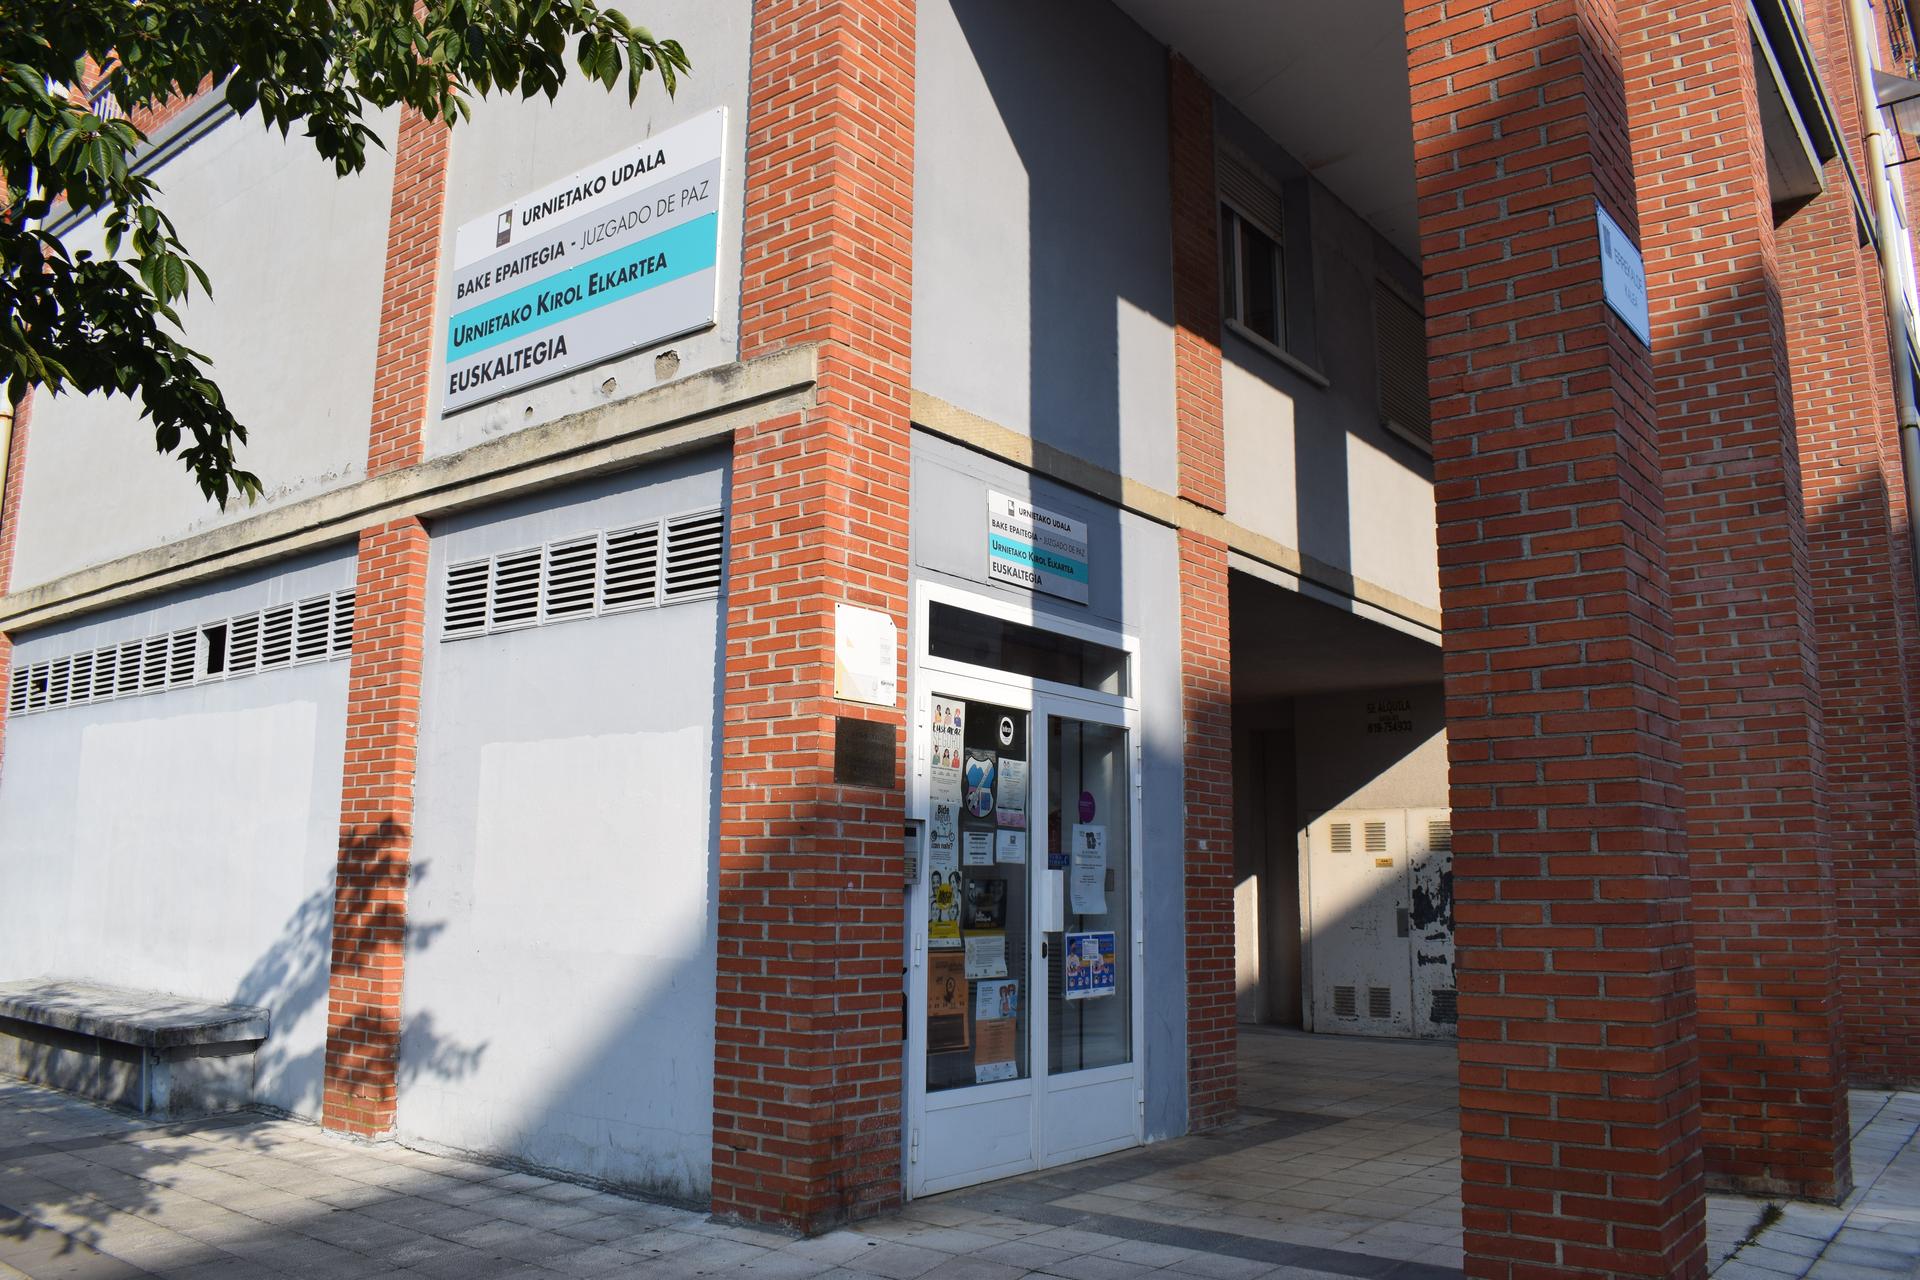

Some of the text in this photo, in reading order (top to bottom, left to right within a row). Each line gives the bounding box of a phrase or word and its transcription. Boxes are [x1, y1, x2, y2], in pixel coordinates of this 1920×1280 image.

[522, 149, 666, 227] URNIETAKO UDALA
[456, 274, 491, 299] BAKE
[495, 240, 565, 284] EPAITEGIA
[580, 205, 651, 250] JUZGADO
[656, 194, 676, 218] DE
[680, 180, 709, 209] PAZ
[453, 252, 668, 347] URNIETAKO KIROL ELKARTEA
[449, 334, 567, 395] EUSKALTEGIA
[991, 519, 1008, 532] BAKE
[1009, 525, 1039, 542] EPAITEGIA
[1043, 536, 1068, 552] JUZGADO
[1068, 544, 1076, 554] DE
[1076, 546, 1085, 557] PAZ
[1019, 507, 1071, 532] URNIETAKO UDALA
[992, 539, 1074, 575] URNIETAKO KIROL ELKARTEA
[992, 562, 1042, 585] EUSKALTEGIA
[1378, 700, 1411, 714] ALQUILA
